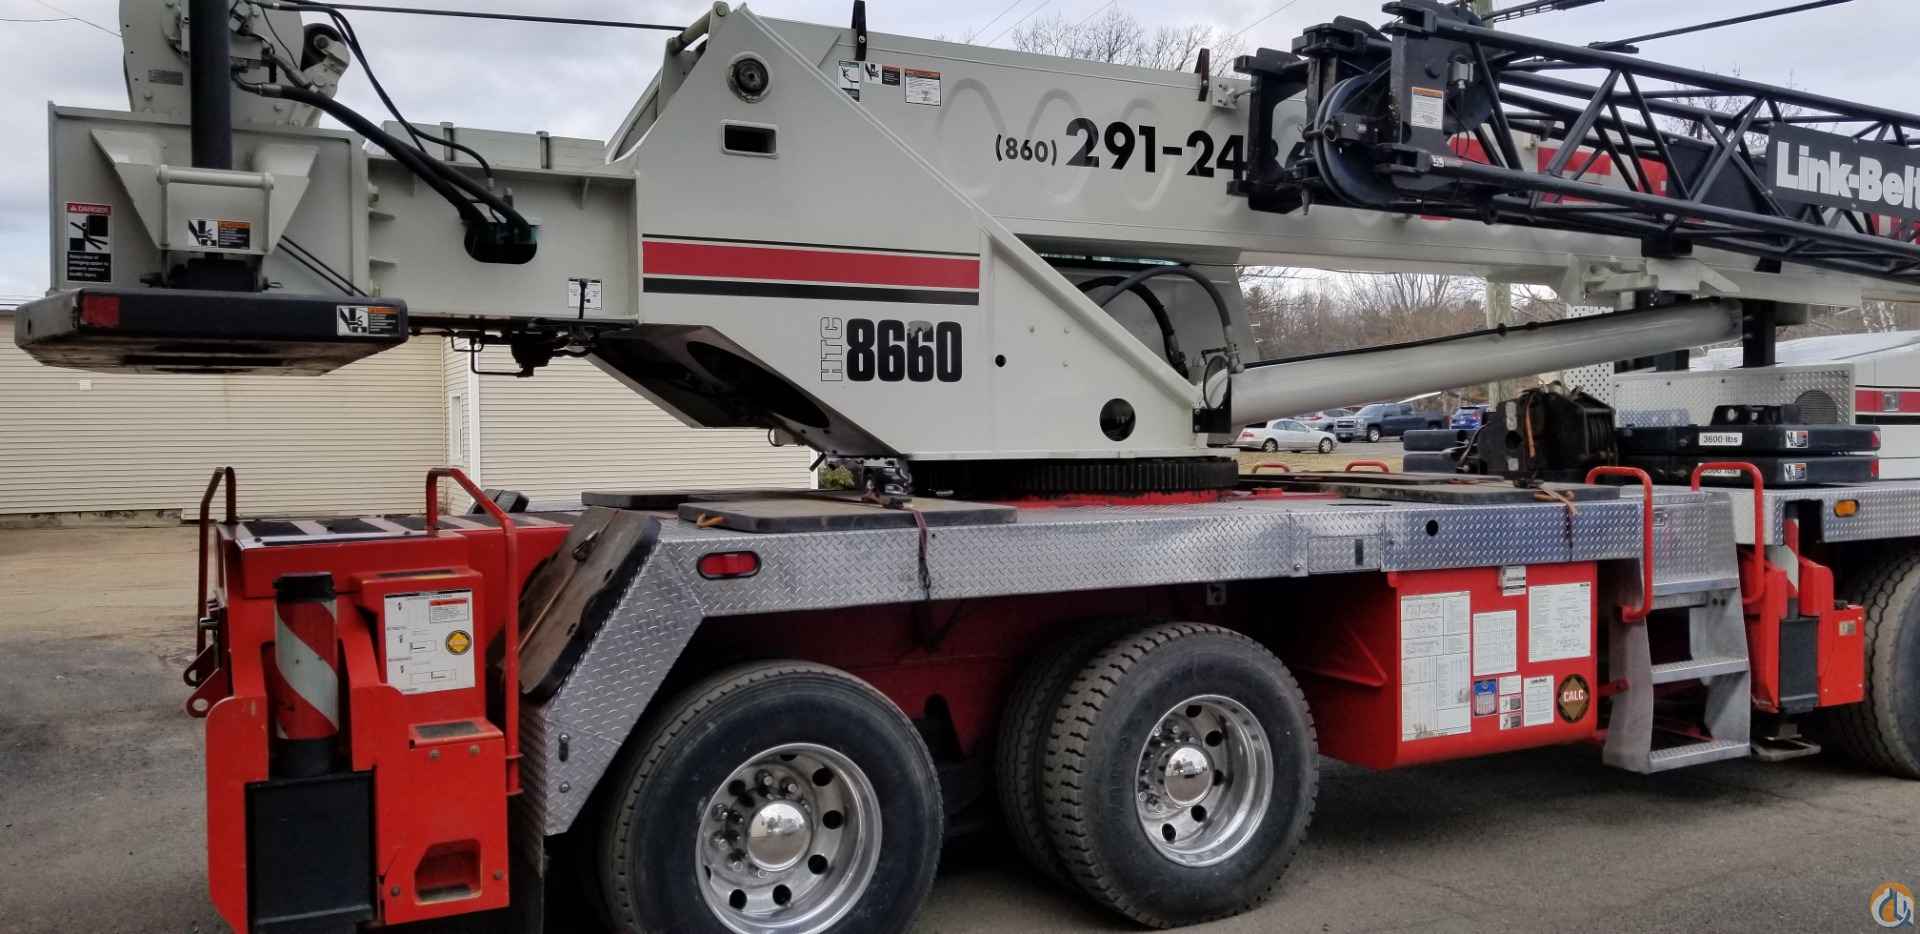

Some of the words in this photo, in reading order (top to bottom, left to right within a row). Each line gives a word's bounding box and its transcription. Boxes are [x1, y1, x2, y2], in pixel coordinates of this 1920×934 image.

[995, 134, 1057, 166] (860)
[820, 316, 843, 382] HTC
[846, 318, 963, 383] 8660
[1725, 434, 1738, 443] lbs
